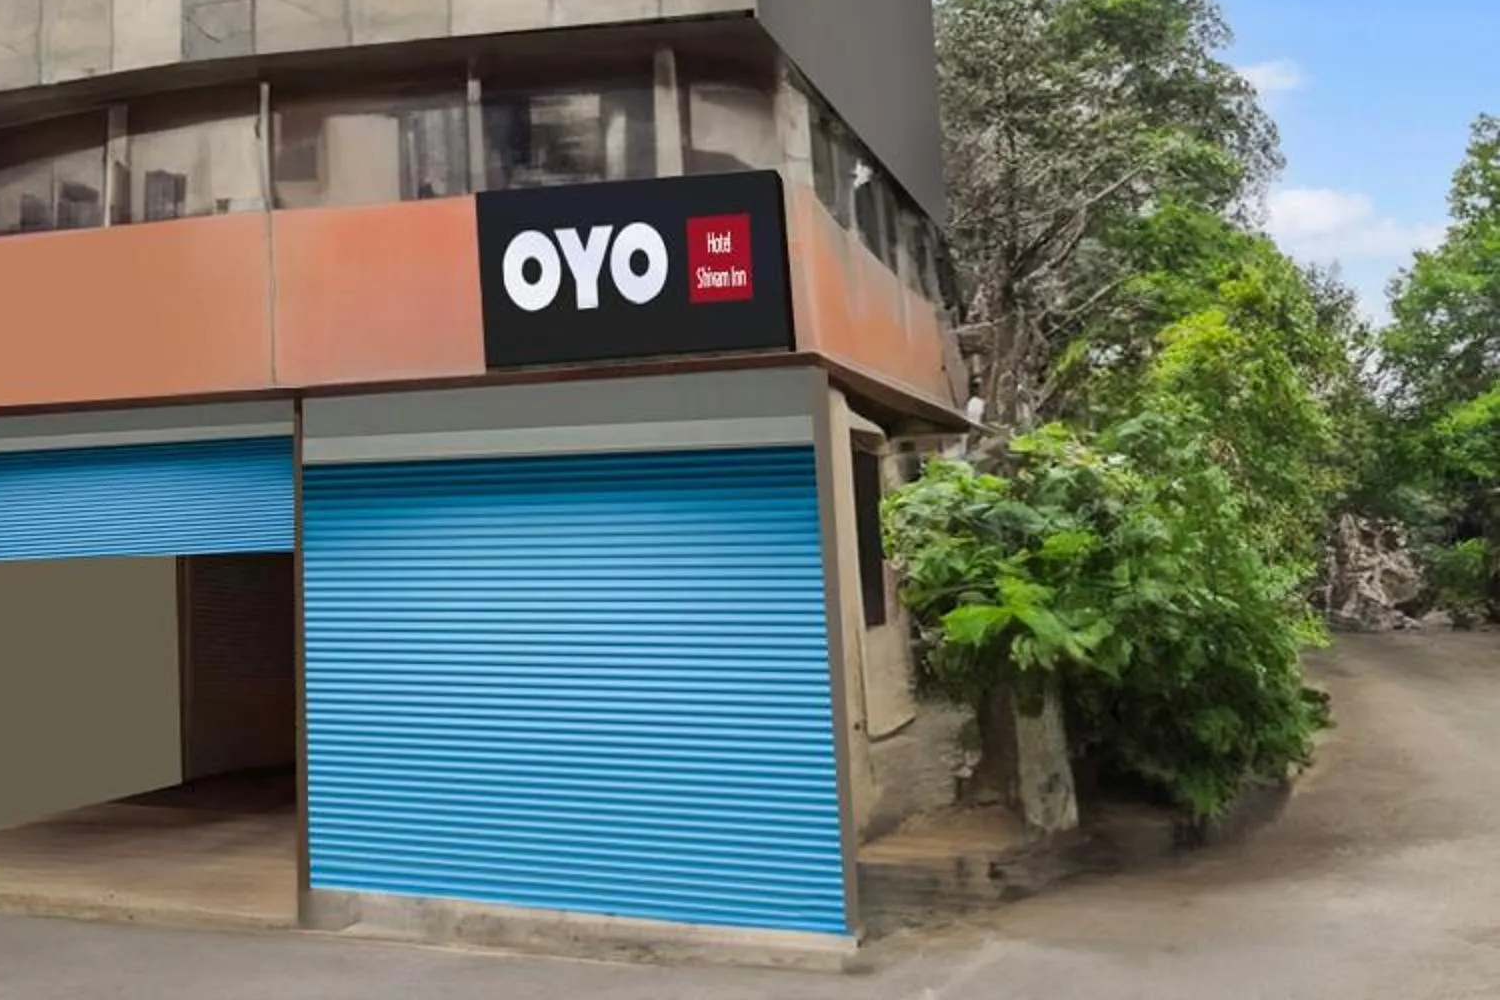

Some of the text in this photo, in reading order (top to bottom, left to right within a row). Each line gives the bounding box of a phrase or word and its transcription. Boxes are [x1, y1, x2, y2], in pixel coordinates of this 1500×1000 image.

[707, 231, 731, 253] Hotel
[503, 221, 669, 312] OYO
[696, 266, 747, 289] Shivam Inn
